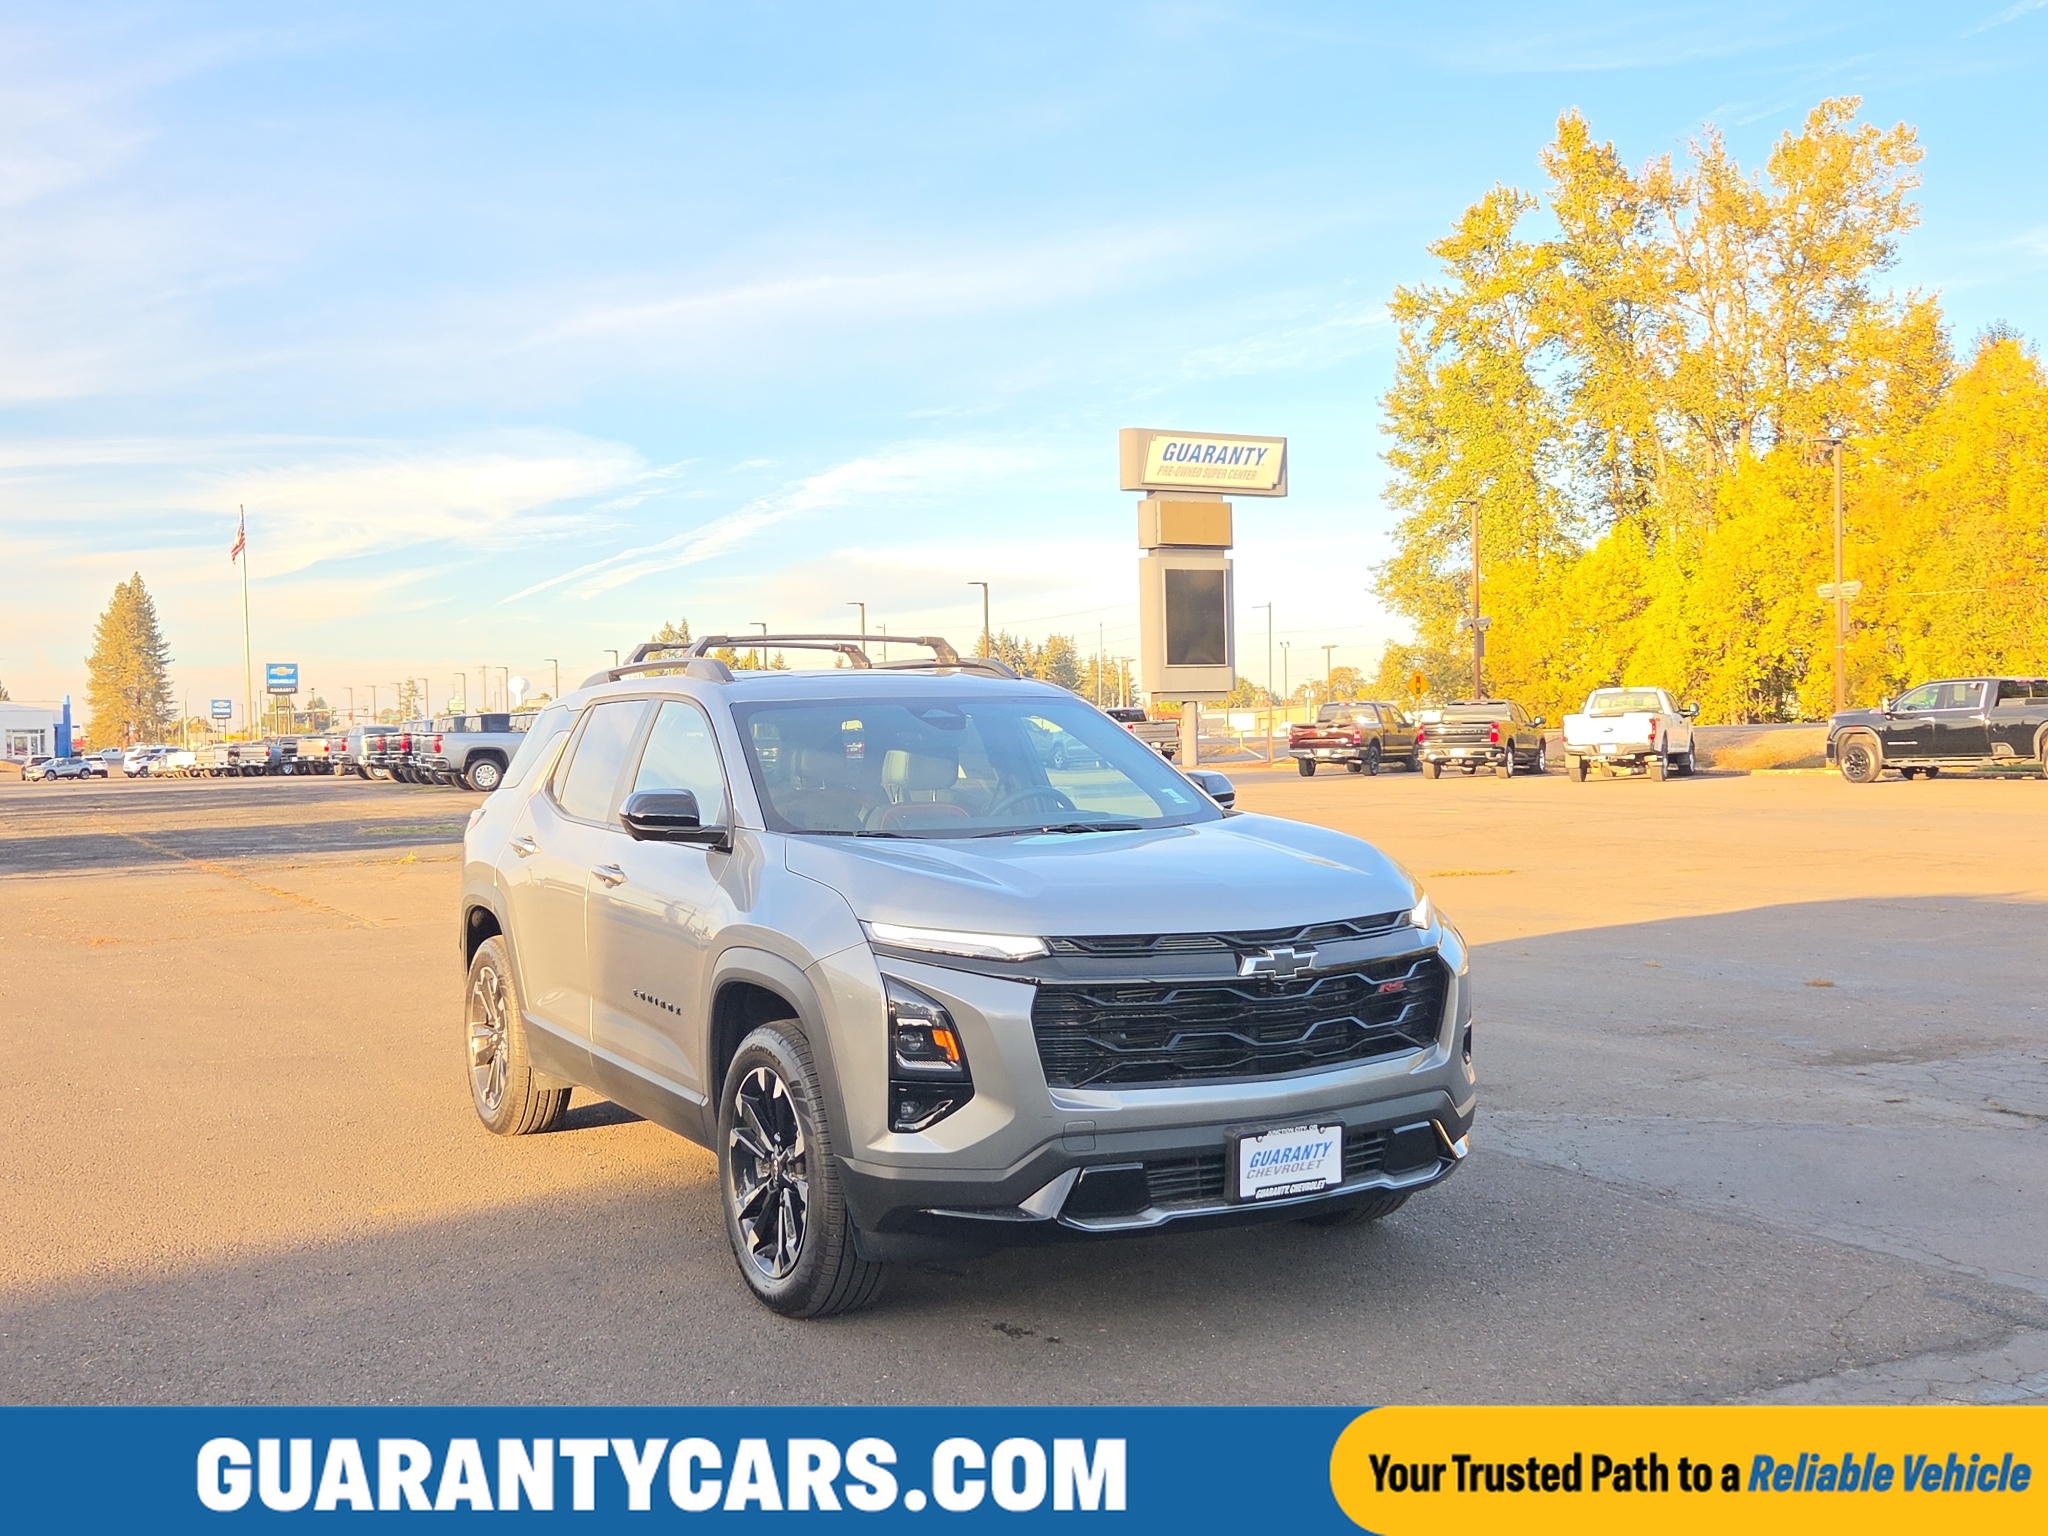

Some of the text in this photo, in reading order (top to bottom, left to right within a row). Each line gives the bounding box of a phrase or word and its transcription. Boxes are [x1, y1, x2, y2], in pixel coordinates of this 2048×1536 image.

[1162, 442, 1269, 466] GUARANTY
[1156, 465, 1257, 480] PRE-OWNED SUPER CENTER
[1249, 1141, 1333, 1168] GUARANTY
[1246, 1160, 1324, 1179] CHEVROLET
